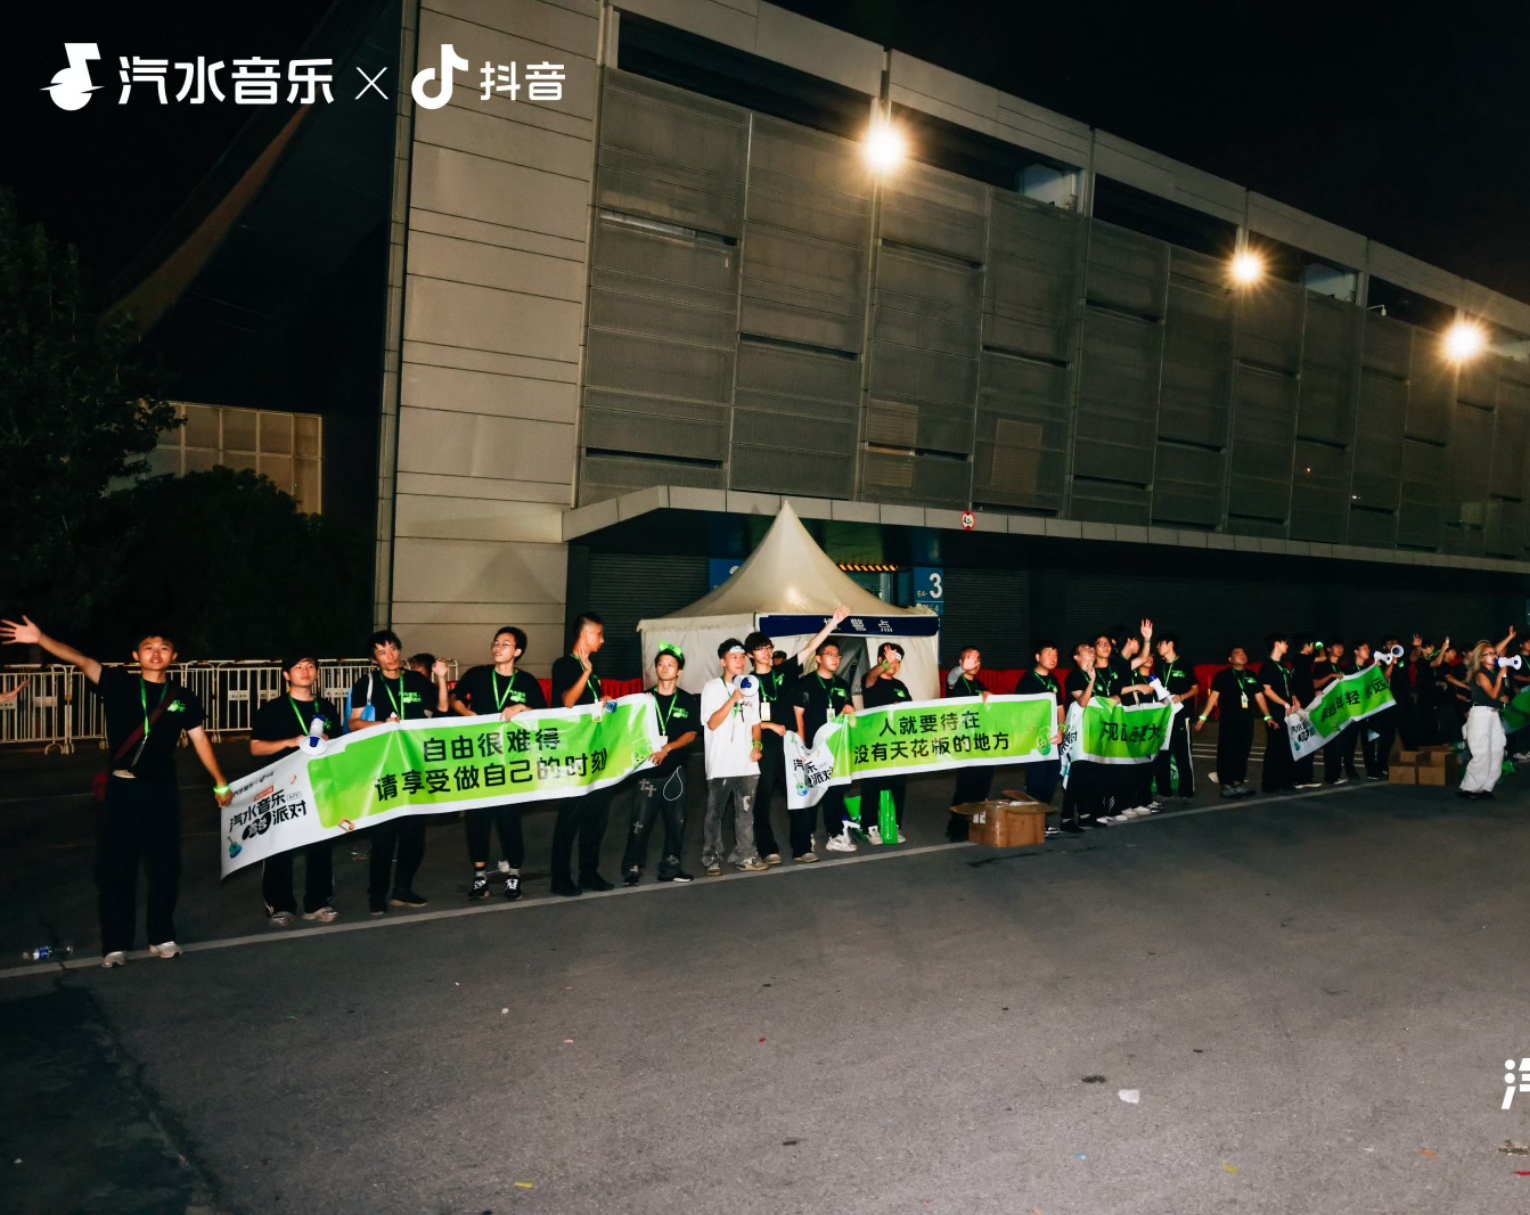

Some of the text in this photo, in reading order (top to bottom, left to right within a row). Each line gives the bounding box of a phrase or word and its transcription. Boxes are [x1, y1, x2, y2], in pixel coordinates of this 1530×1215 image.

[879, 710, 981, 738] 人就要待在
[423, 727, 561, 764] 自由很难得
[374, 748, 608, 803] 请享受做自己的时刻
